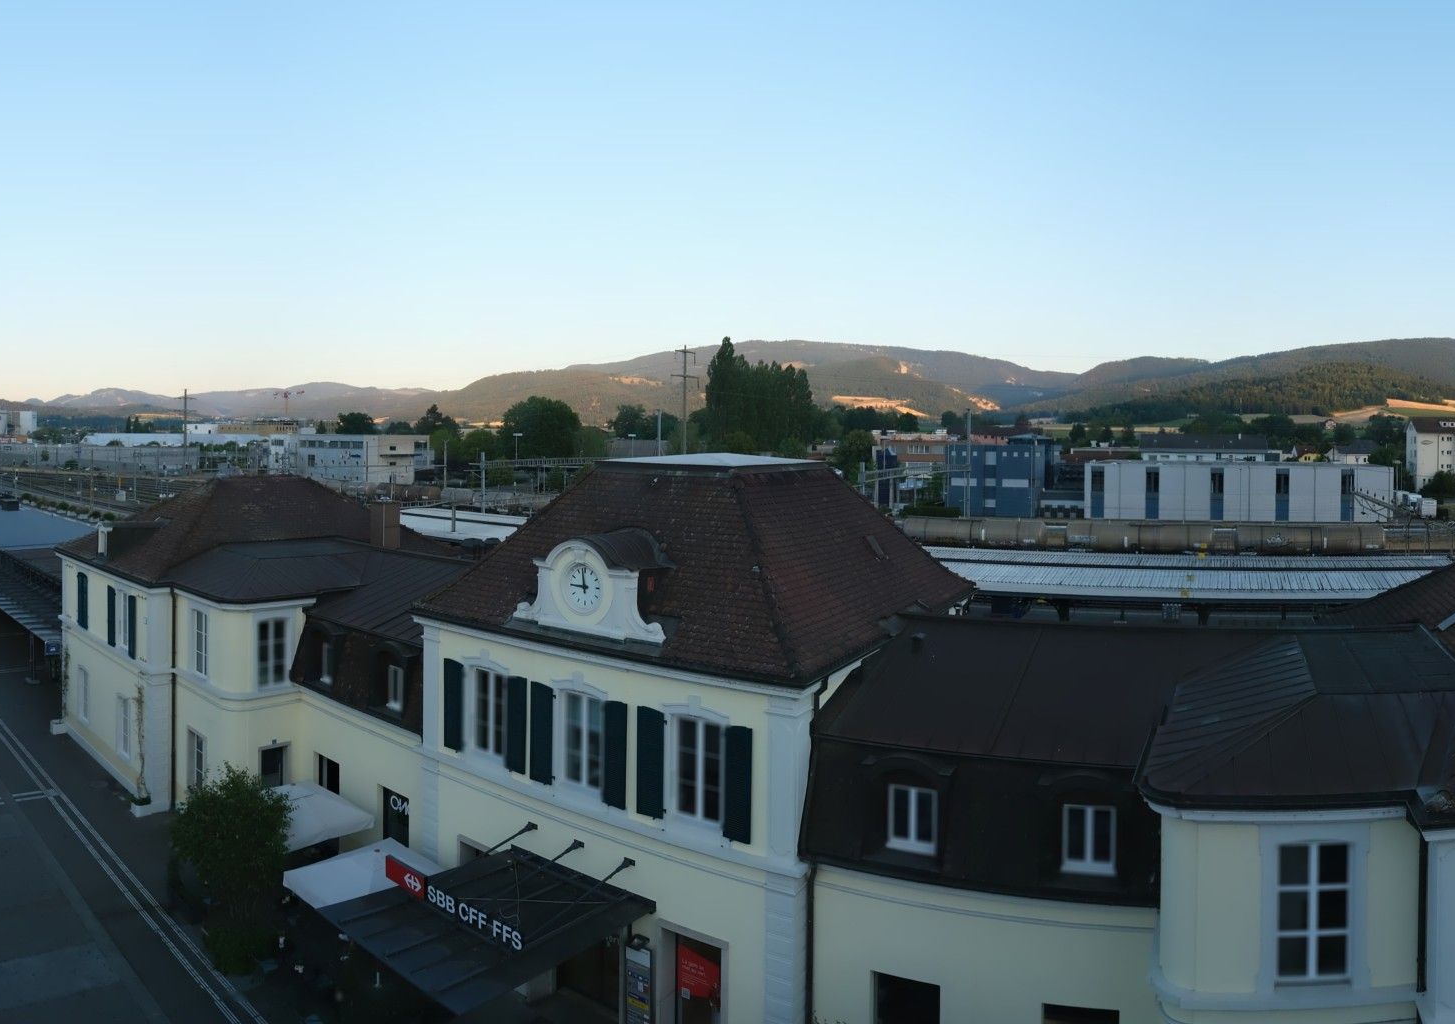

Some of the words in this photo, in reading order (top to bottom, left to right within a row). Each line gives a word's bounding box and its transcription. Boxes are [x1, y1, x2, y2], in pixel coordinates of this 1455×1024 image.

[427, 885, 455, 913] SBB
[458, 902, 487, 930] CFF
[493, 919, 523, 951] FFS
